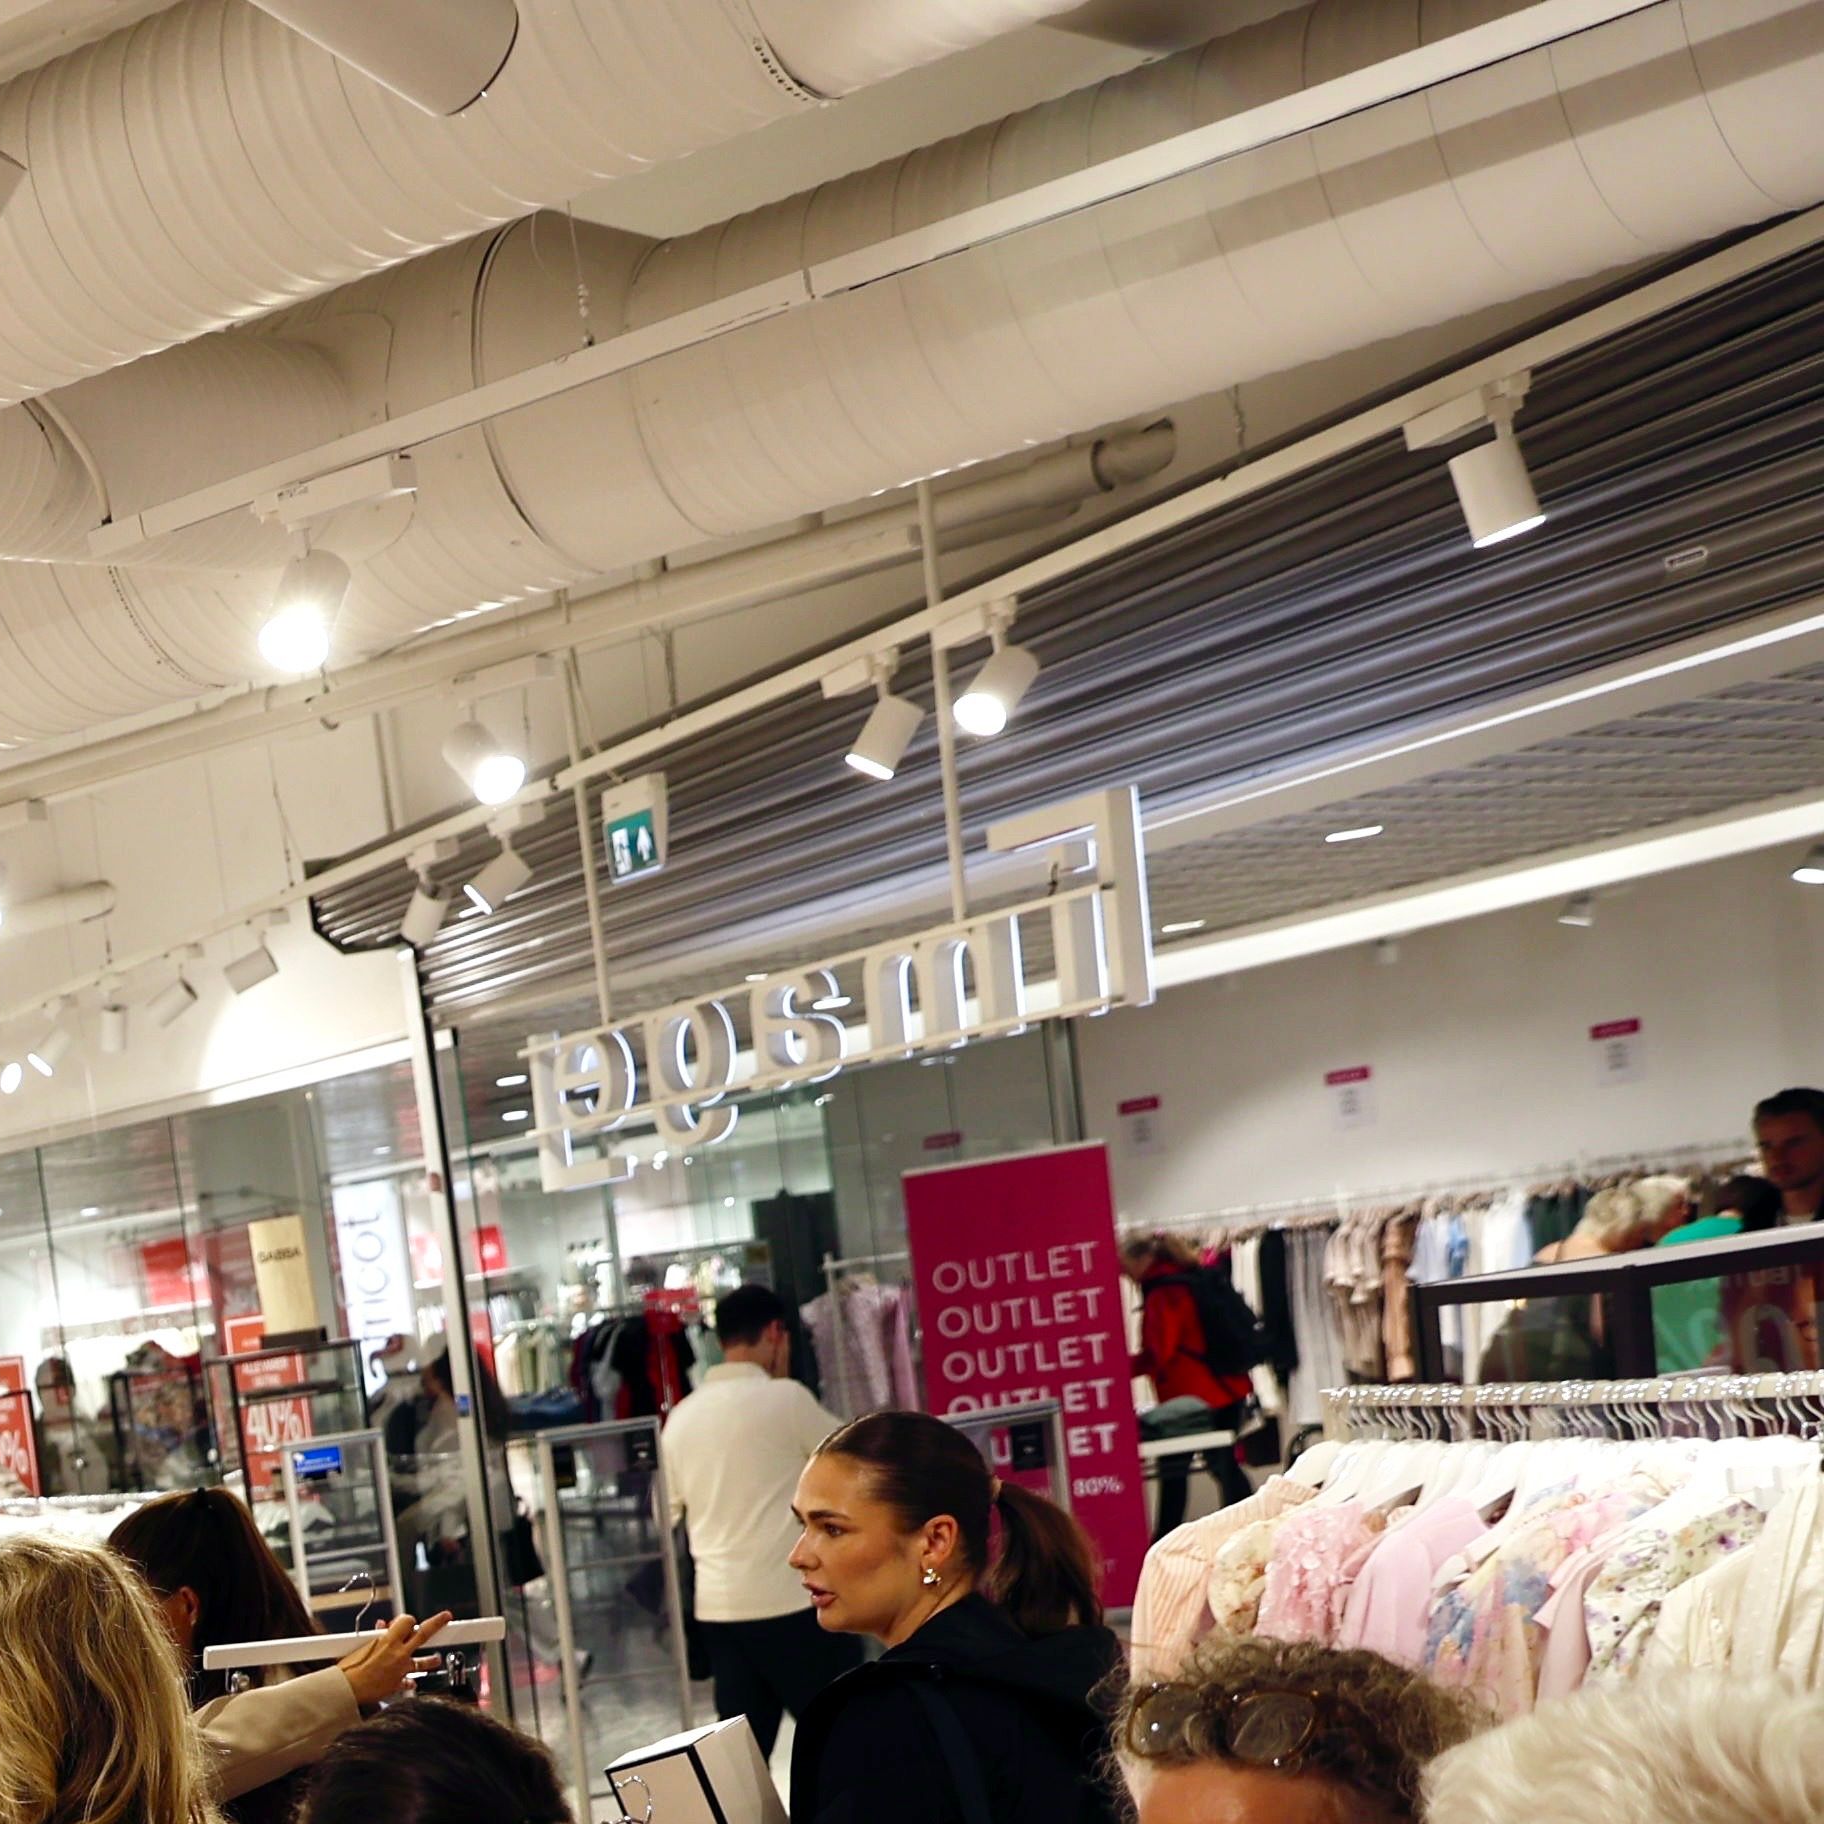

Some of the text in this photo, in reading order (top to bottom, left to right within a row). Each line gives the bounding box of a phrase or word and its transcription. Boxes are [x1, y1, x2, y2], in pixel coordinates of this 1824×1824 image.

[932, 1241, 1099, 1294] OUTLET
[937, 1287, 1104, 1339] OUTLET
[942, 1332, 1110, 1383] OUTLET
